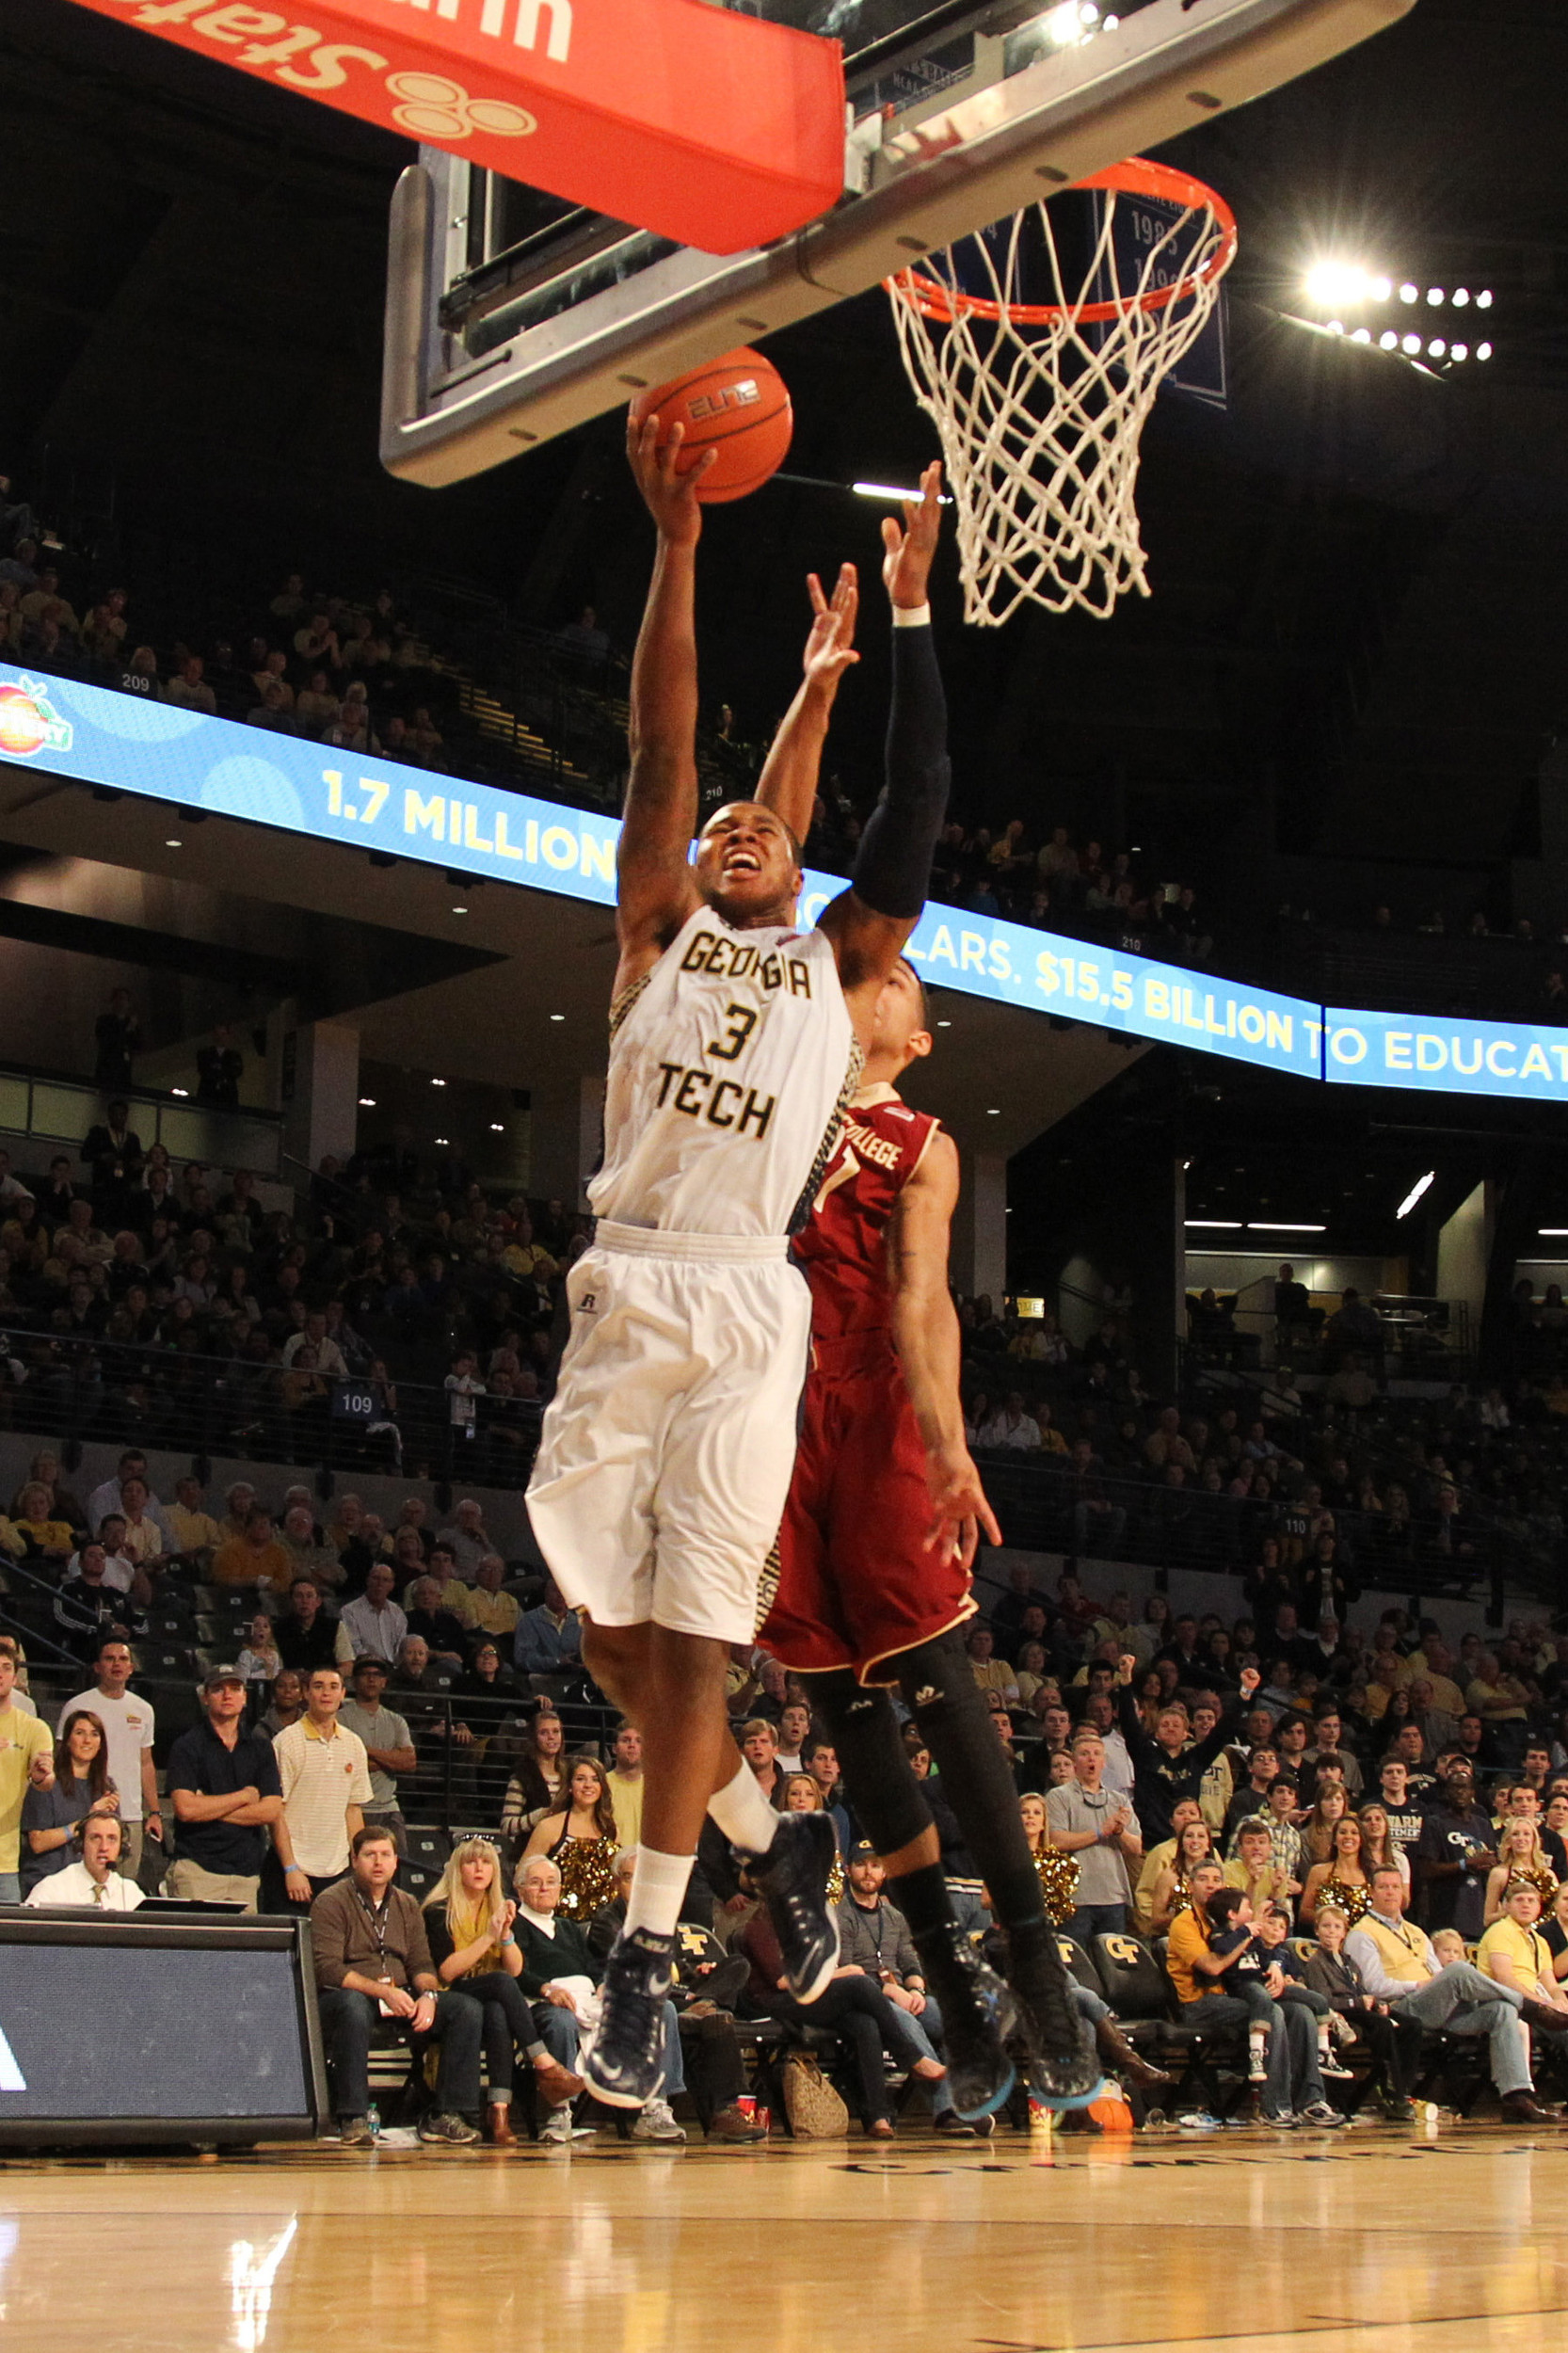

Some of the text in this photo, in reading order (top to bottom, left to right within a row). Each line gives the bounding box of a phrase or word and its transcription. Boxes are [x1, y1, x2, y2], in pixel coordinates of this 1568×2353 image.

[105, 0, 389, 89] Stat
[686, 378, 760, 420] ELITE
[121, 673, 150, 692] 209
[706, 786, 723, 801] 210
[322, 769, 390, 824] 1.7
[405, 789, 617, 882] MILLION
[1035, 951, 1132, 1010] $15.5
[1144, 978, 1293, 1053] BILLION
[1304, 1019, 1367, 1064] TO
[1122, 936, 1141, 951] 210
[680, 931, 811, 999] GEORGIA
[708, 1002, 757, 1061] 3
[656, 1063, 775, 1139] TECH
[343, 1394, 372, 1414] 109
[1286, 1518, 1306, 1534] 110
[1057, 1943, 1073, 1963] T
[1105, 1937, 1139, 1963] GT
